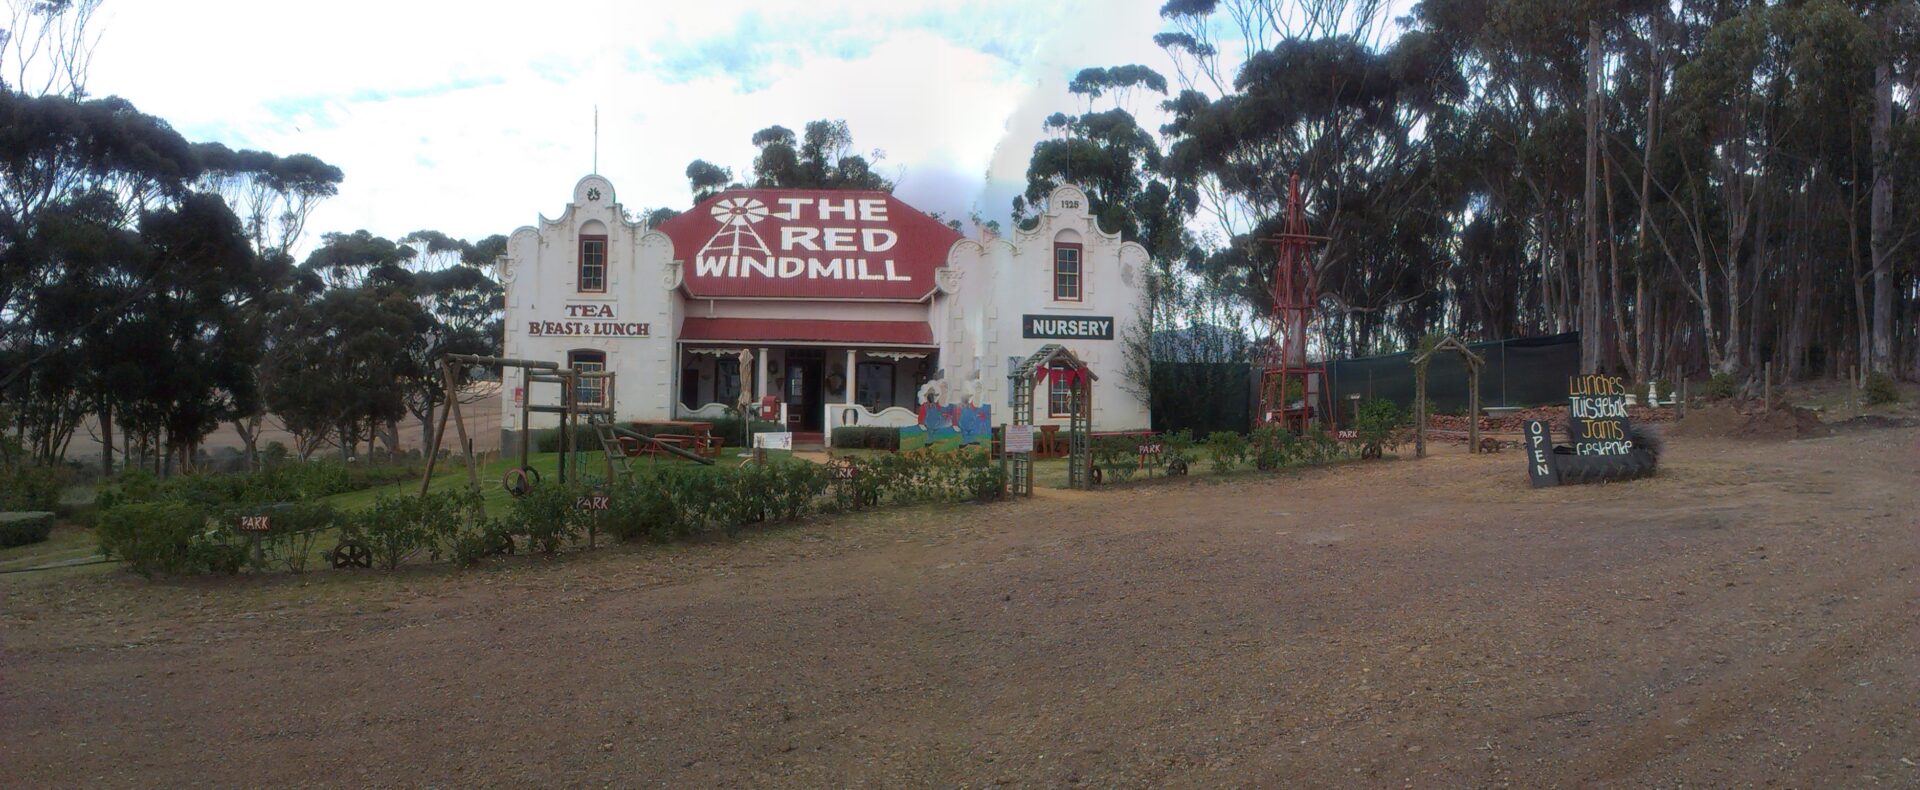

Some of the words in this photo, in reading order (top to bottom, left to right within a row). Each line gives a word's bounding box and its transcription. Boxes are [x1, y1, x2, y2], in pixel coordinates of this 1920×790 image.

[778, 198, 888, 221] THE
[781, 227, 898, 252] RED
[696, 254, 912, 281] WINDMILL
[565, 304, 614, 318] TEA
[529, 320, 583, 336] B/FAST
[584, 326, 590, 334] &
[593, 322, 650, 336] LUNCH
[1032, 319, 1110, 336] NURSERY
[1569, 374, 1625, 396] Lunches
[1569, 396, 1629, 419] Tuisgebak
[1338, 430, 1358, 439] PARK
[1581, 419, 1624, 440] Jams
[1138, 444, 1160, 454] PARK
[1531, 421, 1549, 476] OPEN
[576, 496, 609, 510] PARK
[241, 516, 268, 530] PARK
